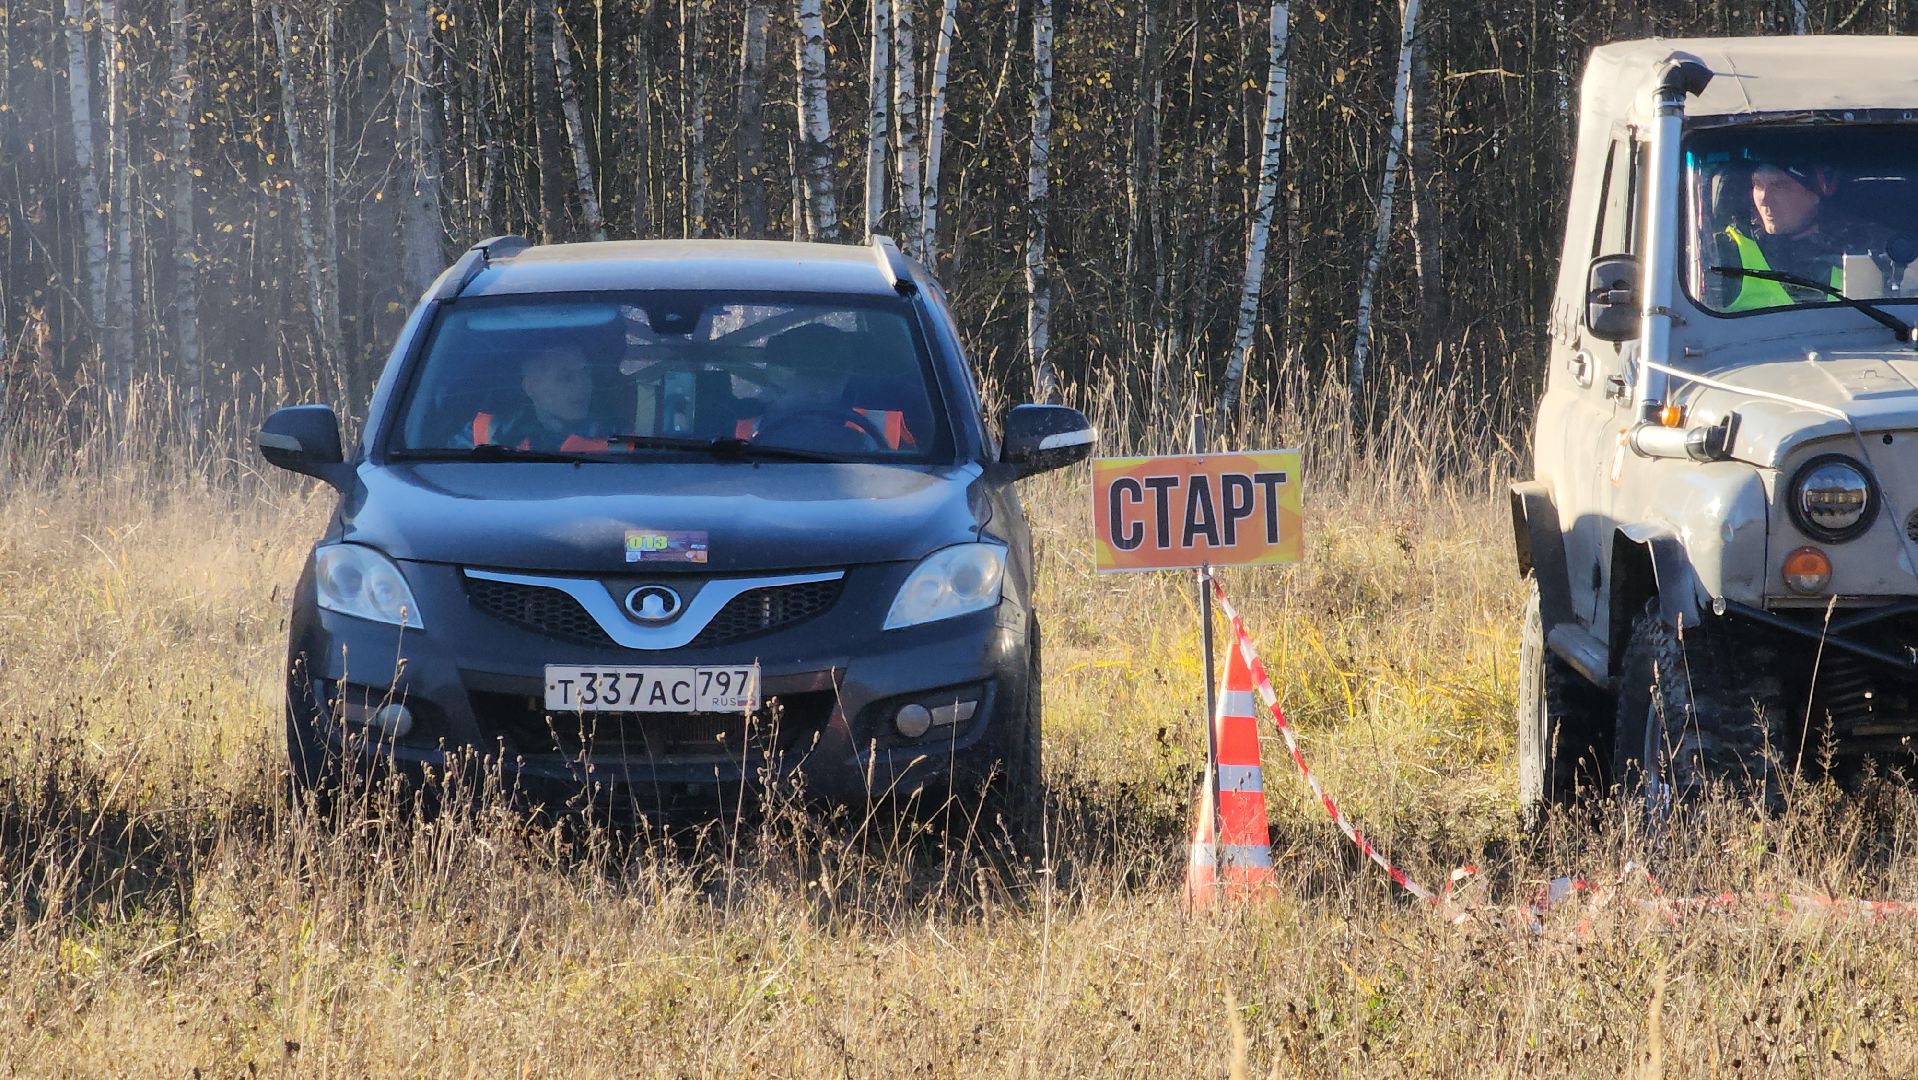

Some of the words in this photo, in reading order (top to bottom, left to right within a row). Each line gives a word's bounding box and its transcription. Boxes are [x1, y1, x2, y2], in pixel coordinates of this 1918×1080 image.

[1109, 472, 1287, 550] СТАРТ
[628, 535, 669, 550] 013
[557, 672, 691, 705] Т337АС
[698, 671, 749, 697] 797
[713, 698, 737, 706] RUS
